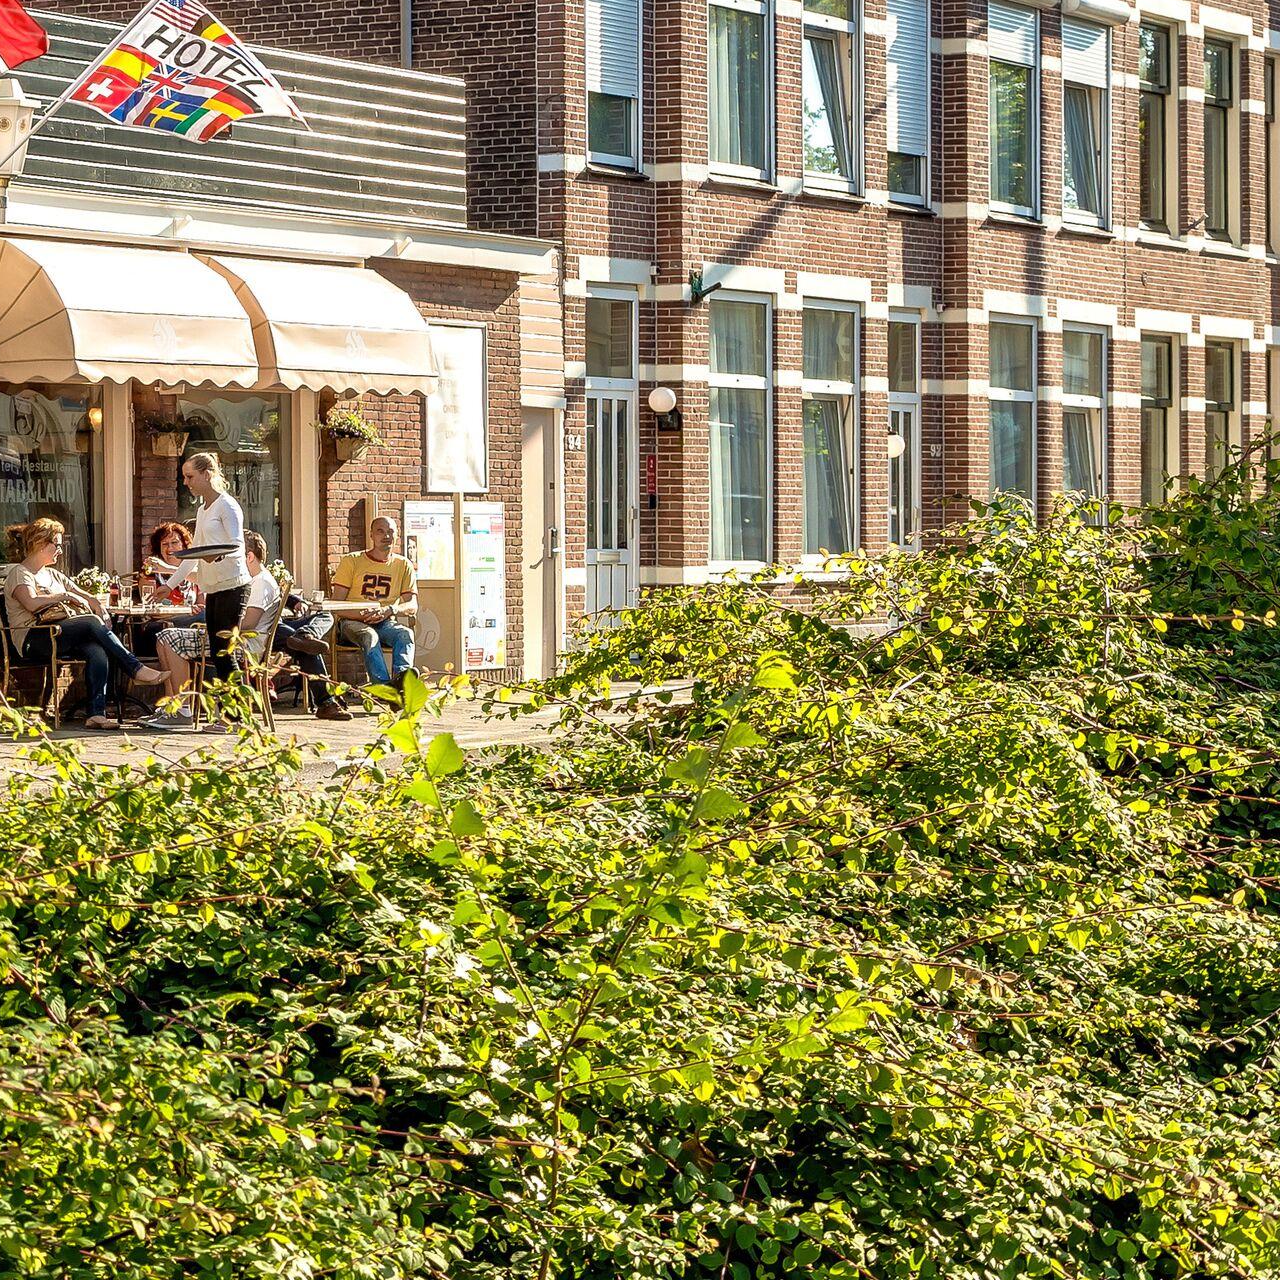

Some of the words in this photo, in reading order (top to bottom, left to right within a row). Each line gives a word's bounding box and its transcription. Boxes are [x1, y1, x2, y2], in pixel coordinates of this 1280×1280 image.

[141, 24, 265, 97] HOTEL
[930, 444, 941, 457] 92
[361, 574, 392, 599] 25
